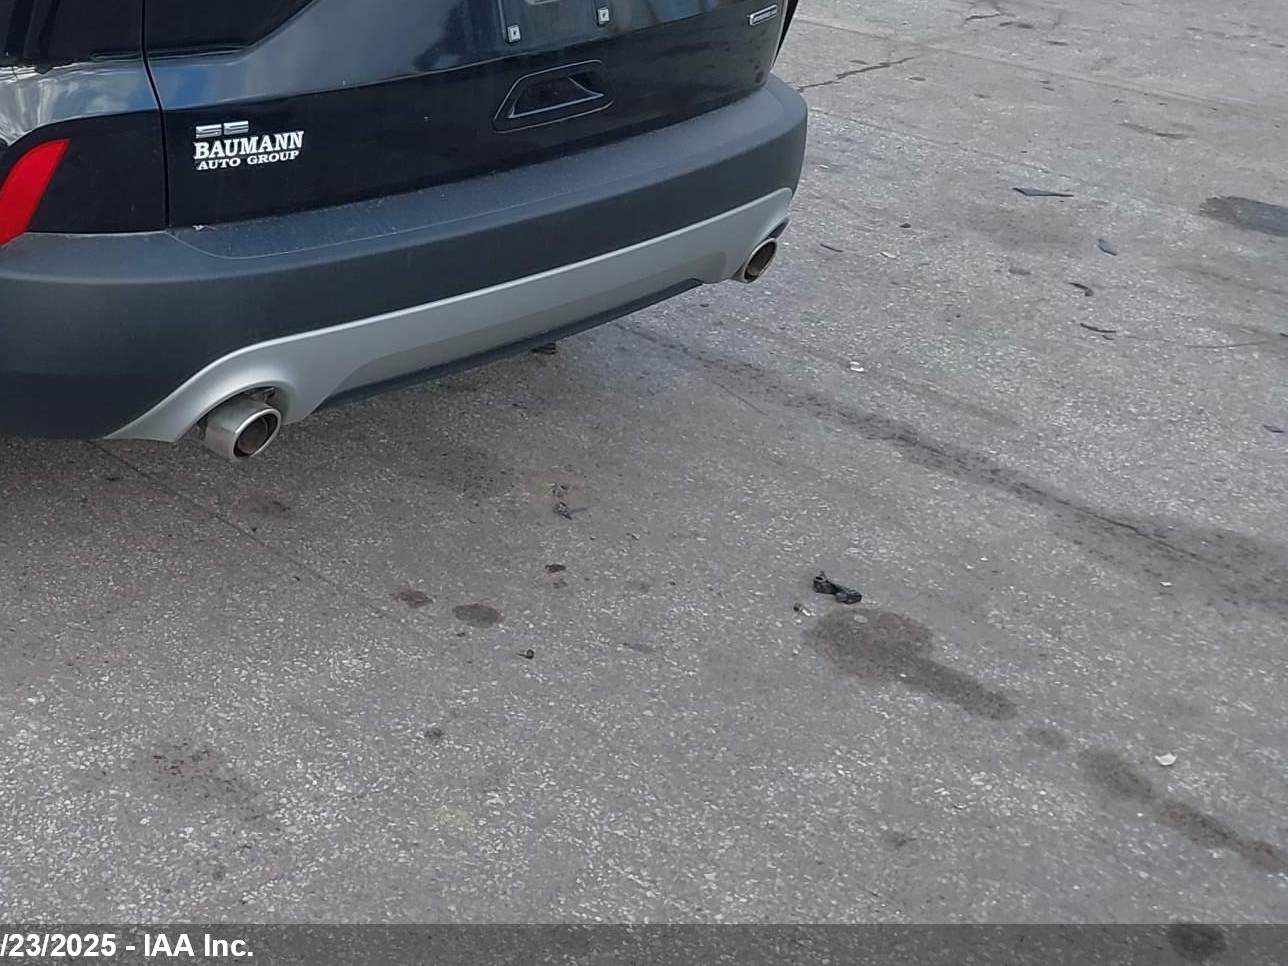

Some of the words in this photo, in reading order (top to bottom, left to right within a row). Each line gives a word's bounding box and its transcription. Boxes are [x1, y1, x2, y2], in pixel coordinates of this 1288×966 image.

[193, 130, 304, 160] BAUMANN
[196, 157, 241, 170] AUTO
[247, 150, 300, 165] GROUP
